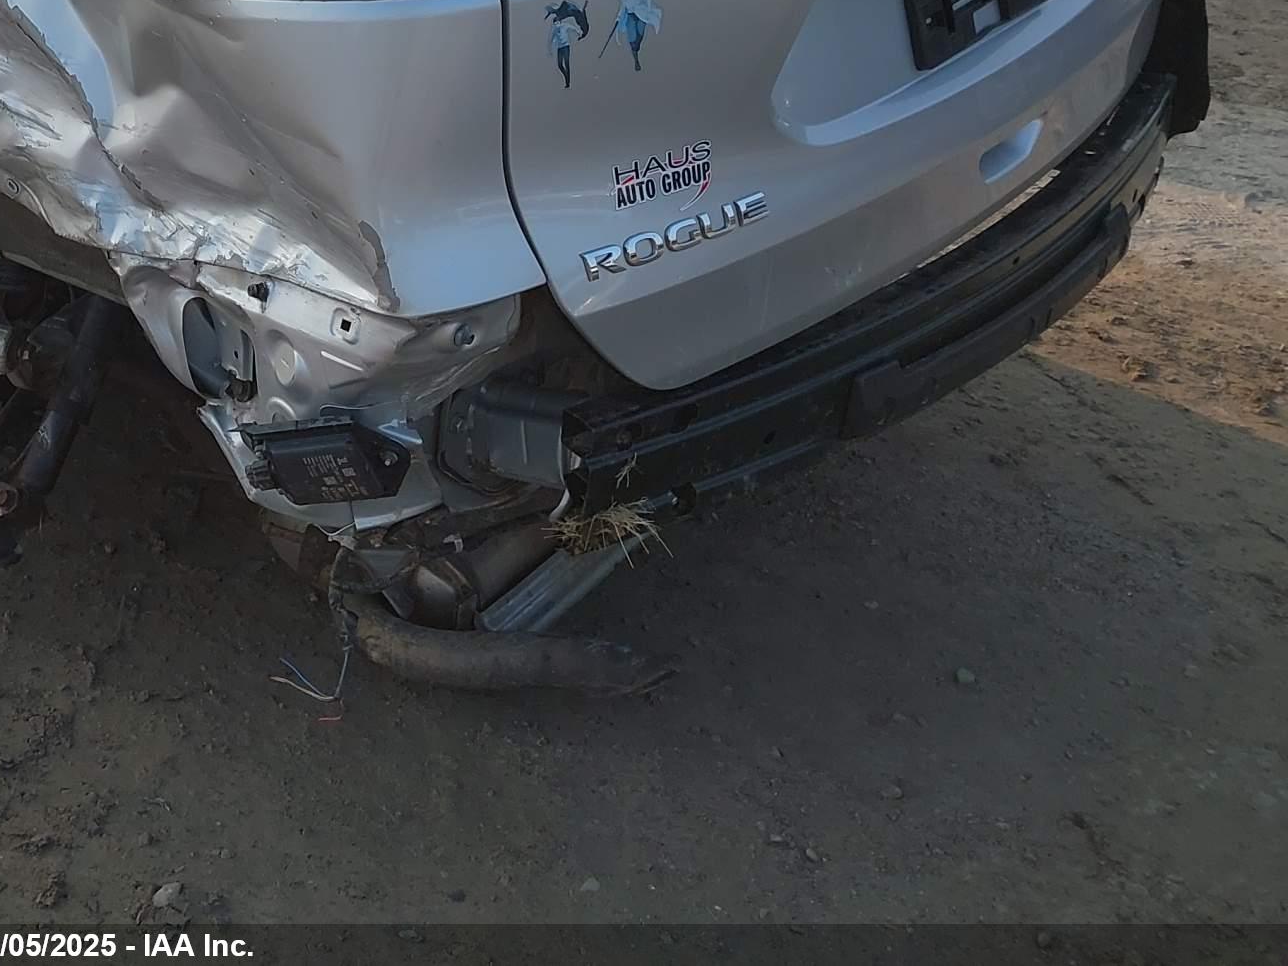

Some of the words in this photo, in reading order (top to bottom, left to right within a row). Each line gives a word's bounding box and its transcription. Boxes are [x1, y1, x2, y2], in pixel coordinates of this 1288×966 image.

[613, 141, 711, 186] HAUS
[616, 178, 656, 209] AUTO
[661, 161, 711, 194] GROUP
[579, 191, 769, 282] ROGUE
